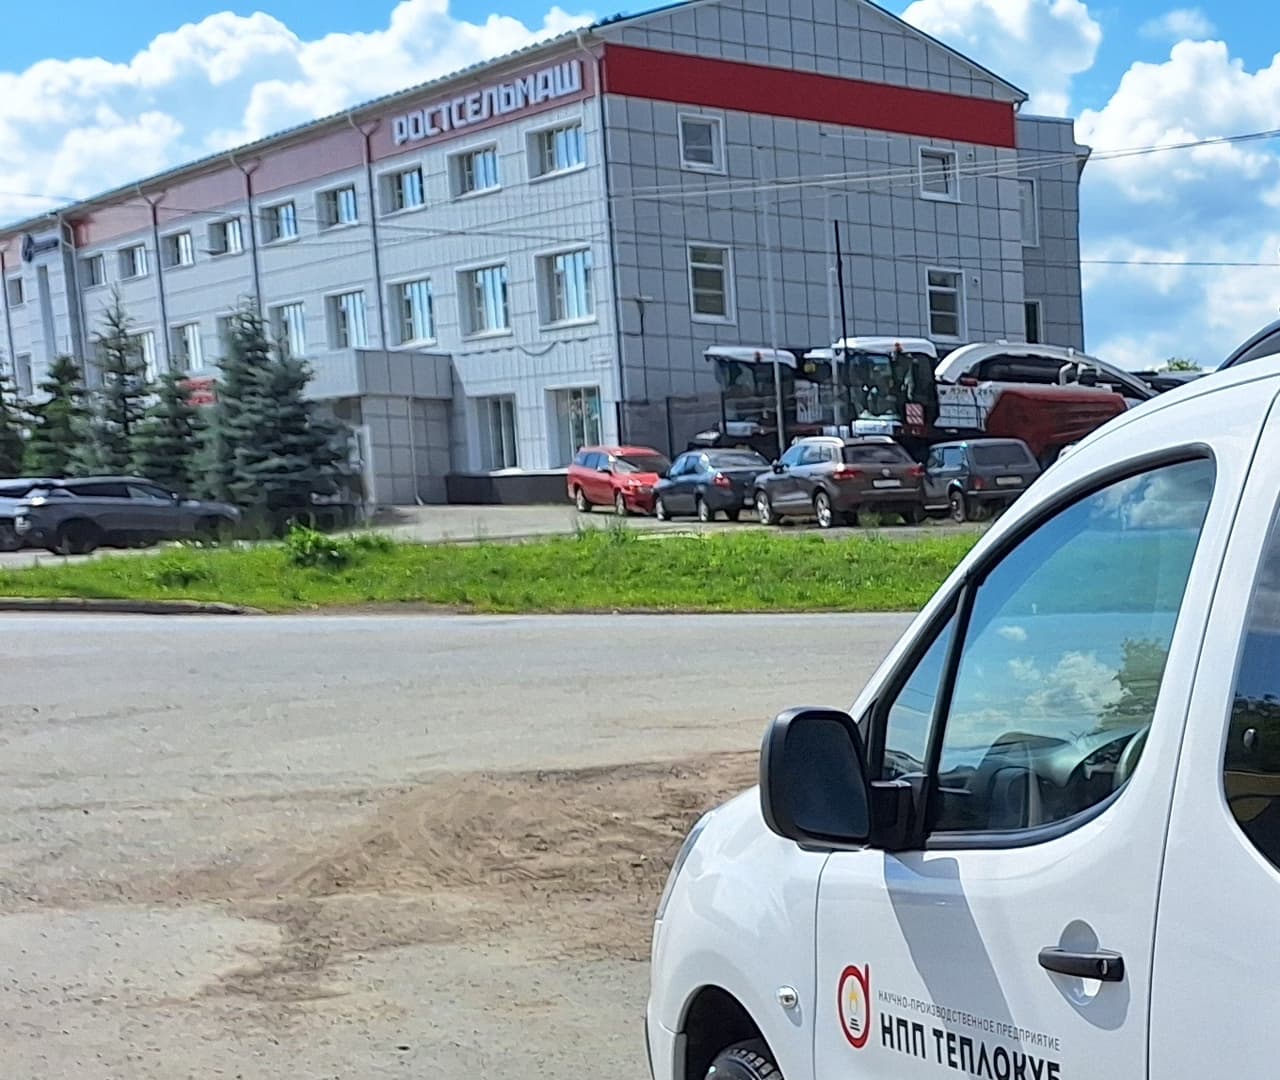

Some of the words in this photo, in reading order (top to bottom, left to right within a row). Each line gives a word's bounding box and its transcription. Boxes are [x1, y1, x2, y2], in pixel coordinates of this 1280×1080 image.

[392, 59, 583, 145] РОСТСЕЛЬМАШ
[878, 990, 994, 1032] НАУЧНО-ПРОИЗВОДСТВЕННОЕ
[996, 1022, 1060, 1051] ПРЕДПРИЯТИЕ
[880, 1013, 926, 1059] НПП
